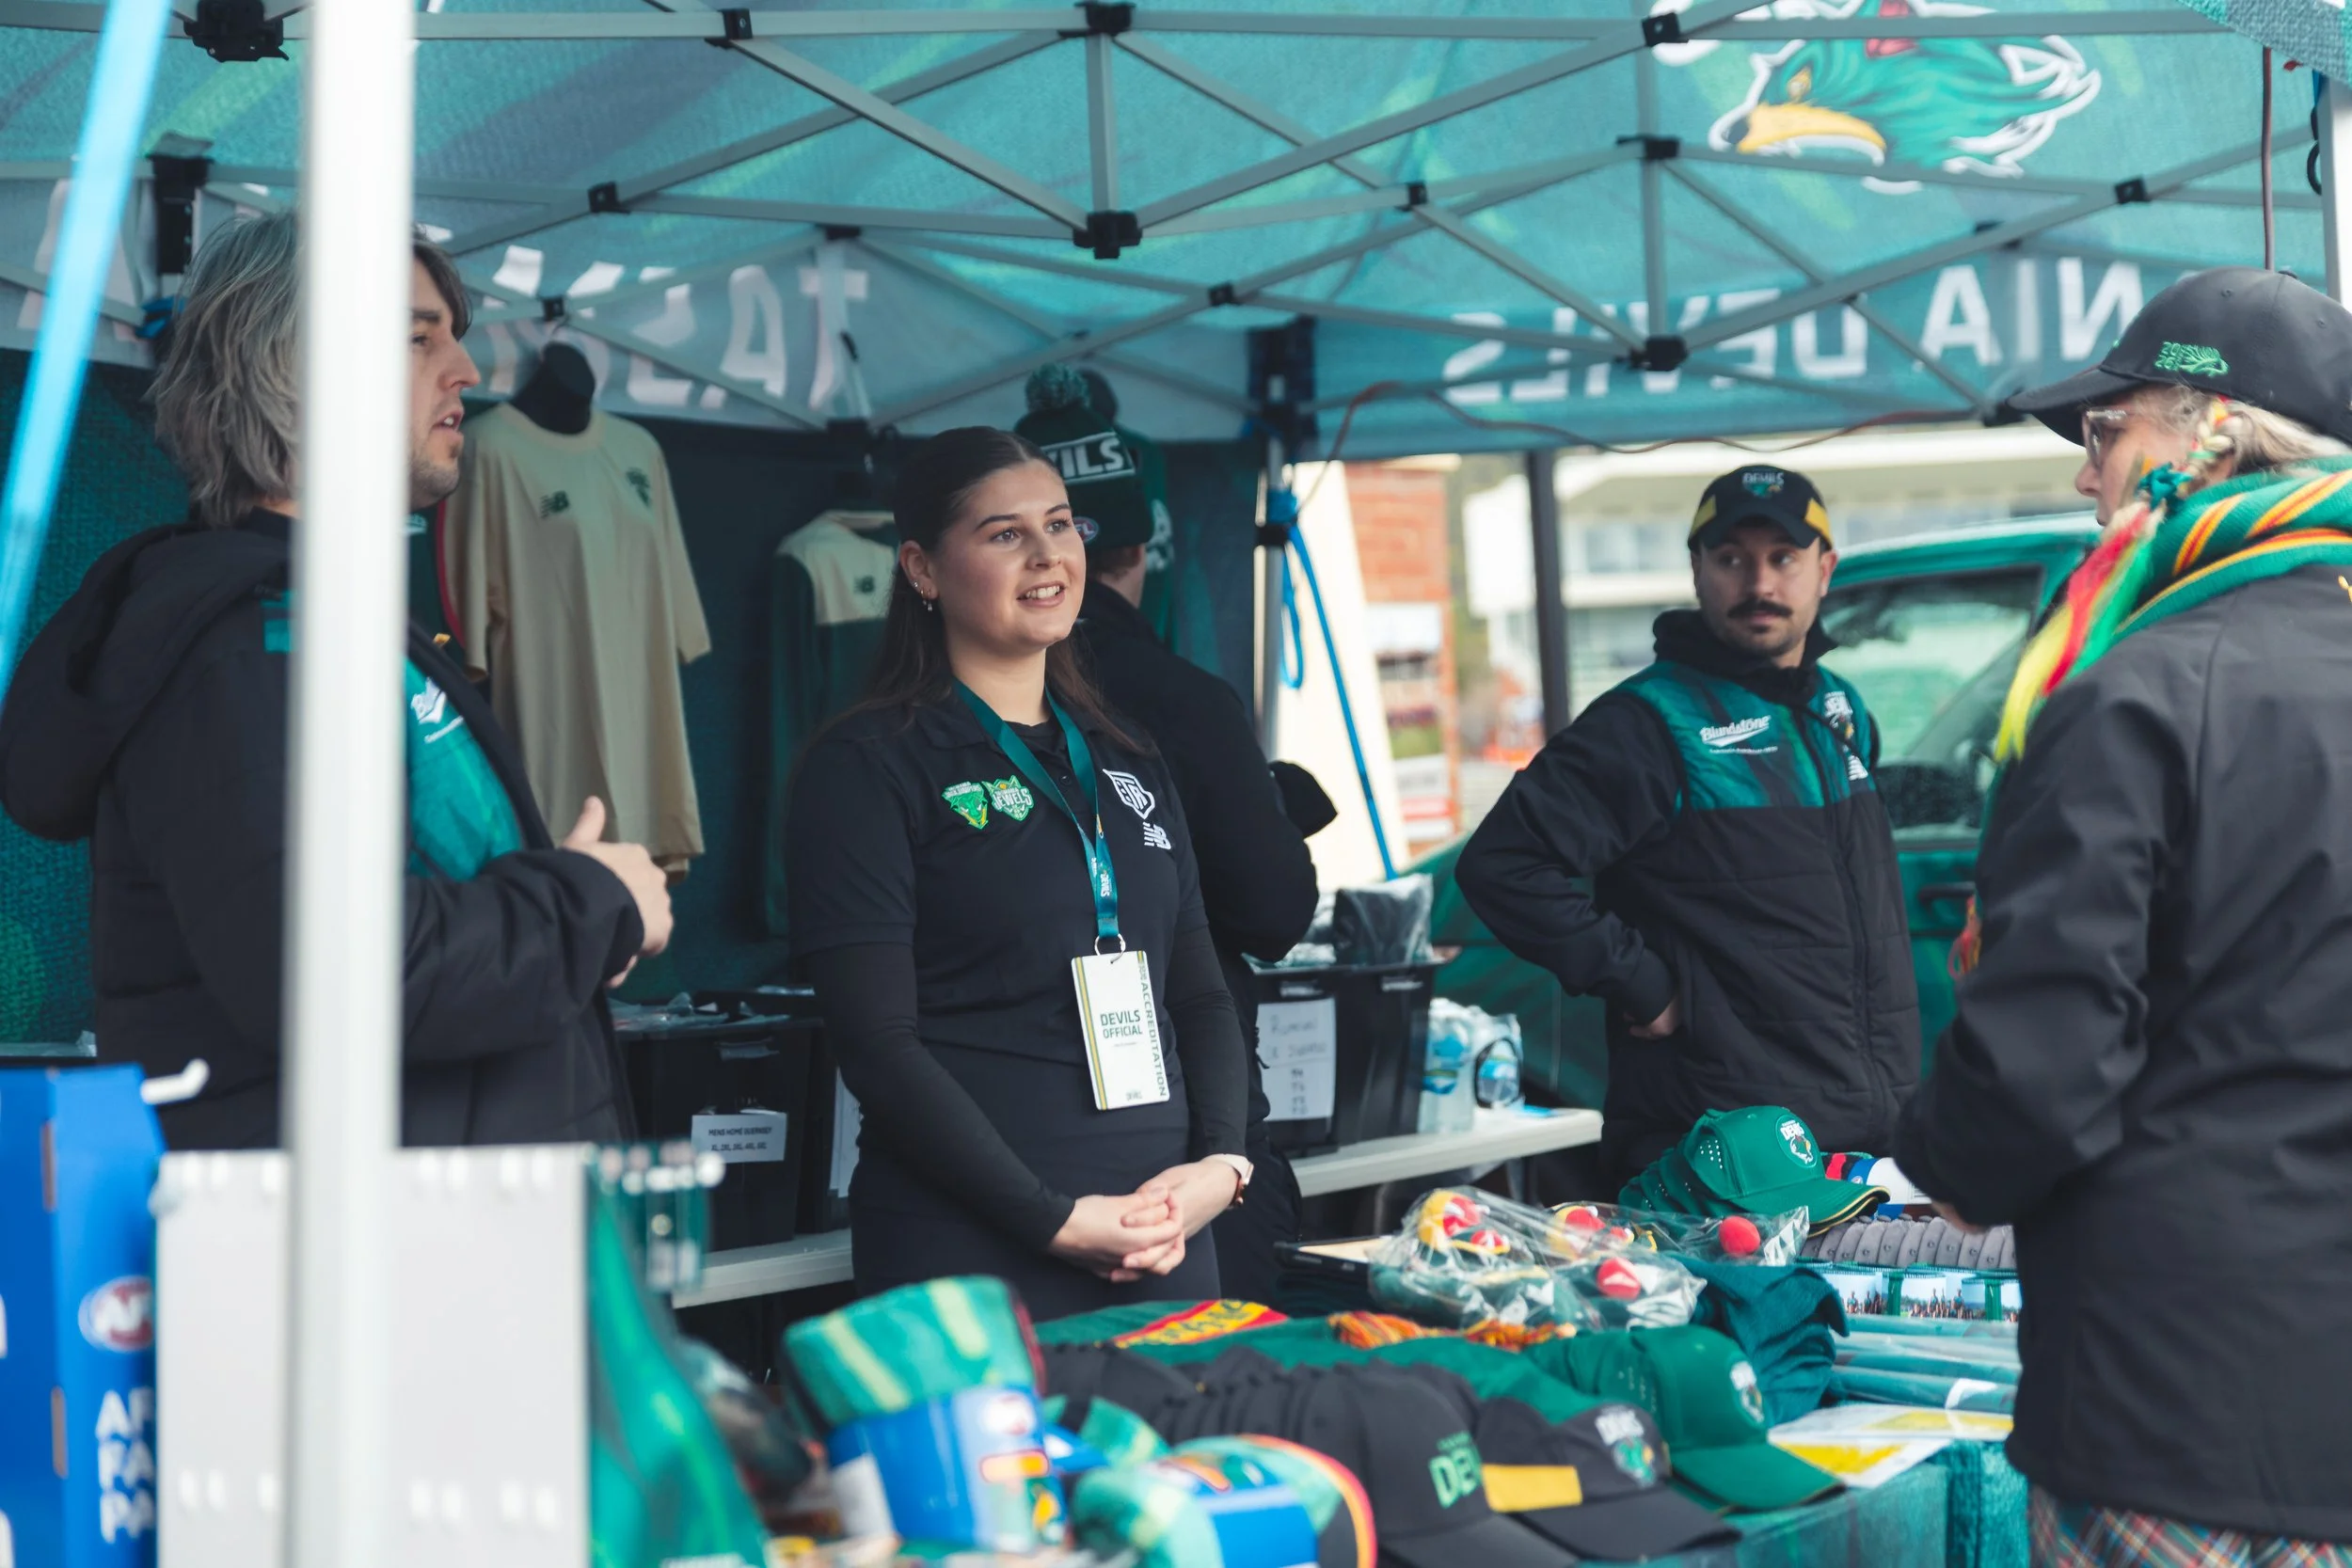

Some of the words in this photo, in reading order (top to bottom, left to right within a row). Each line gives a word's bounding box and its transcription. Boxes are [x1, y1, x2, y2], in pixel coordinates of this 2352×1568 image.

[1699, 715, 1772, 743] Blundstone
[993, 788, 1033, 810] JEWELS
[1100, 1009, 1141, 1026] DEVILS
[1103, 1024, 1144, 1039] OFFICIAL
[1140, 982, 1168, 1097] ACCREDITATION
